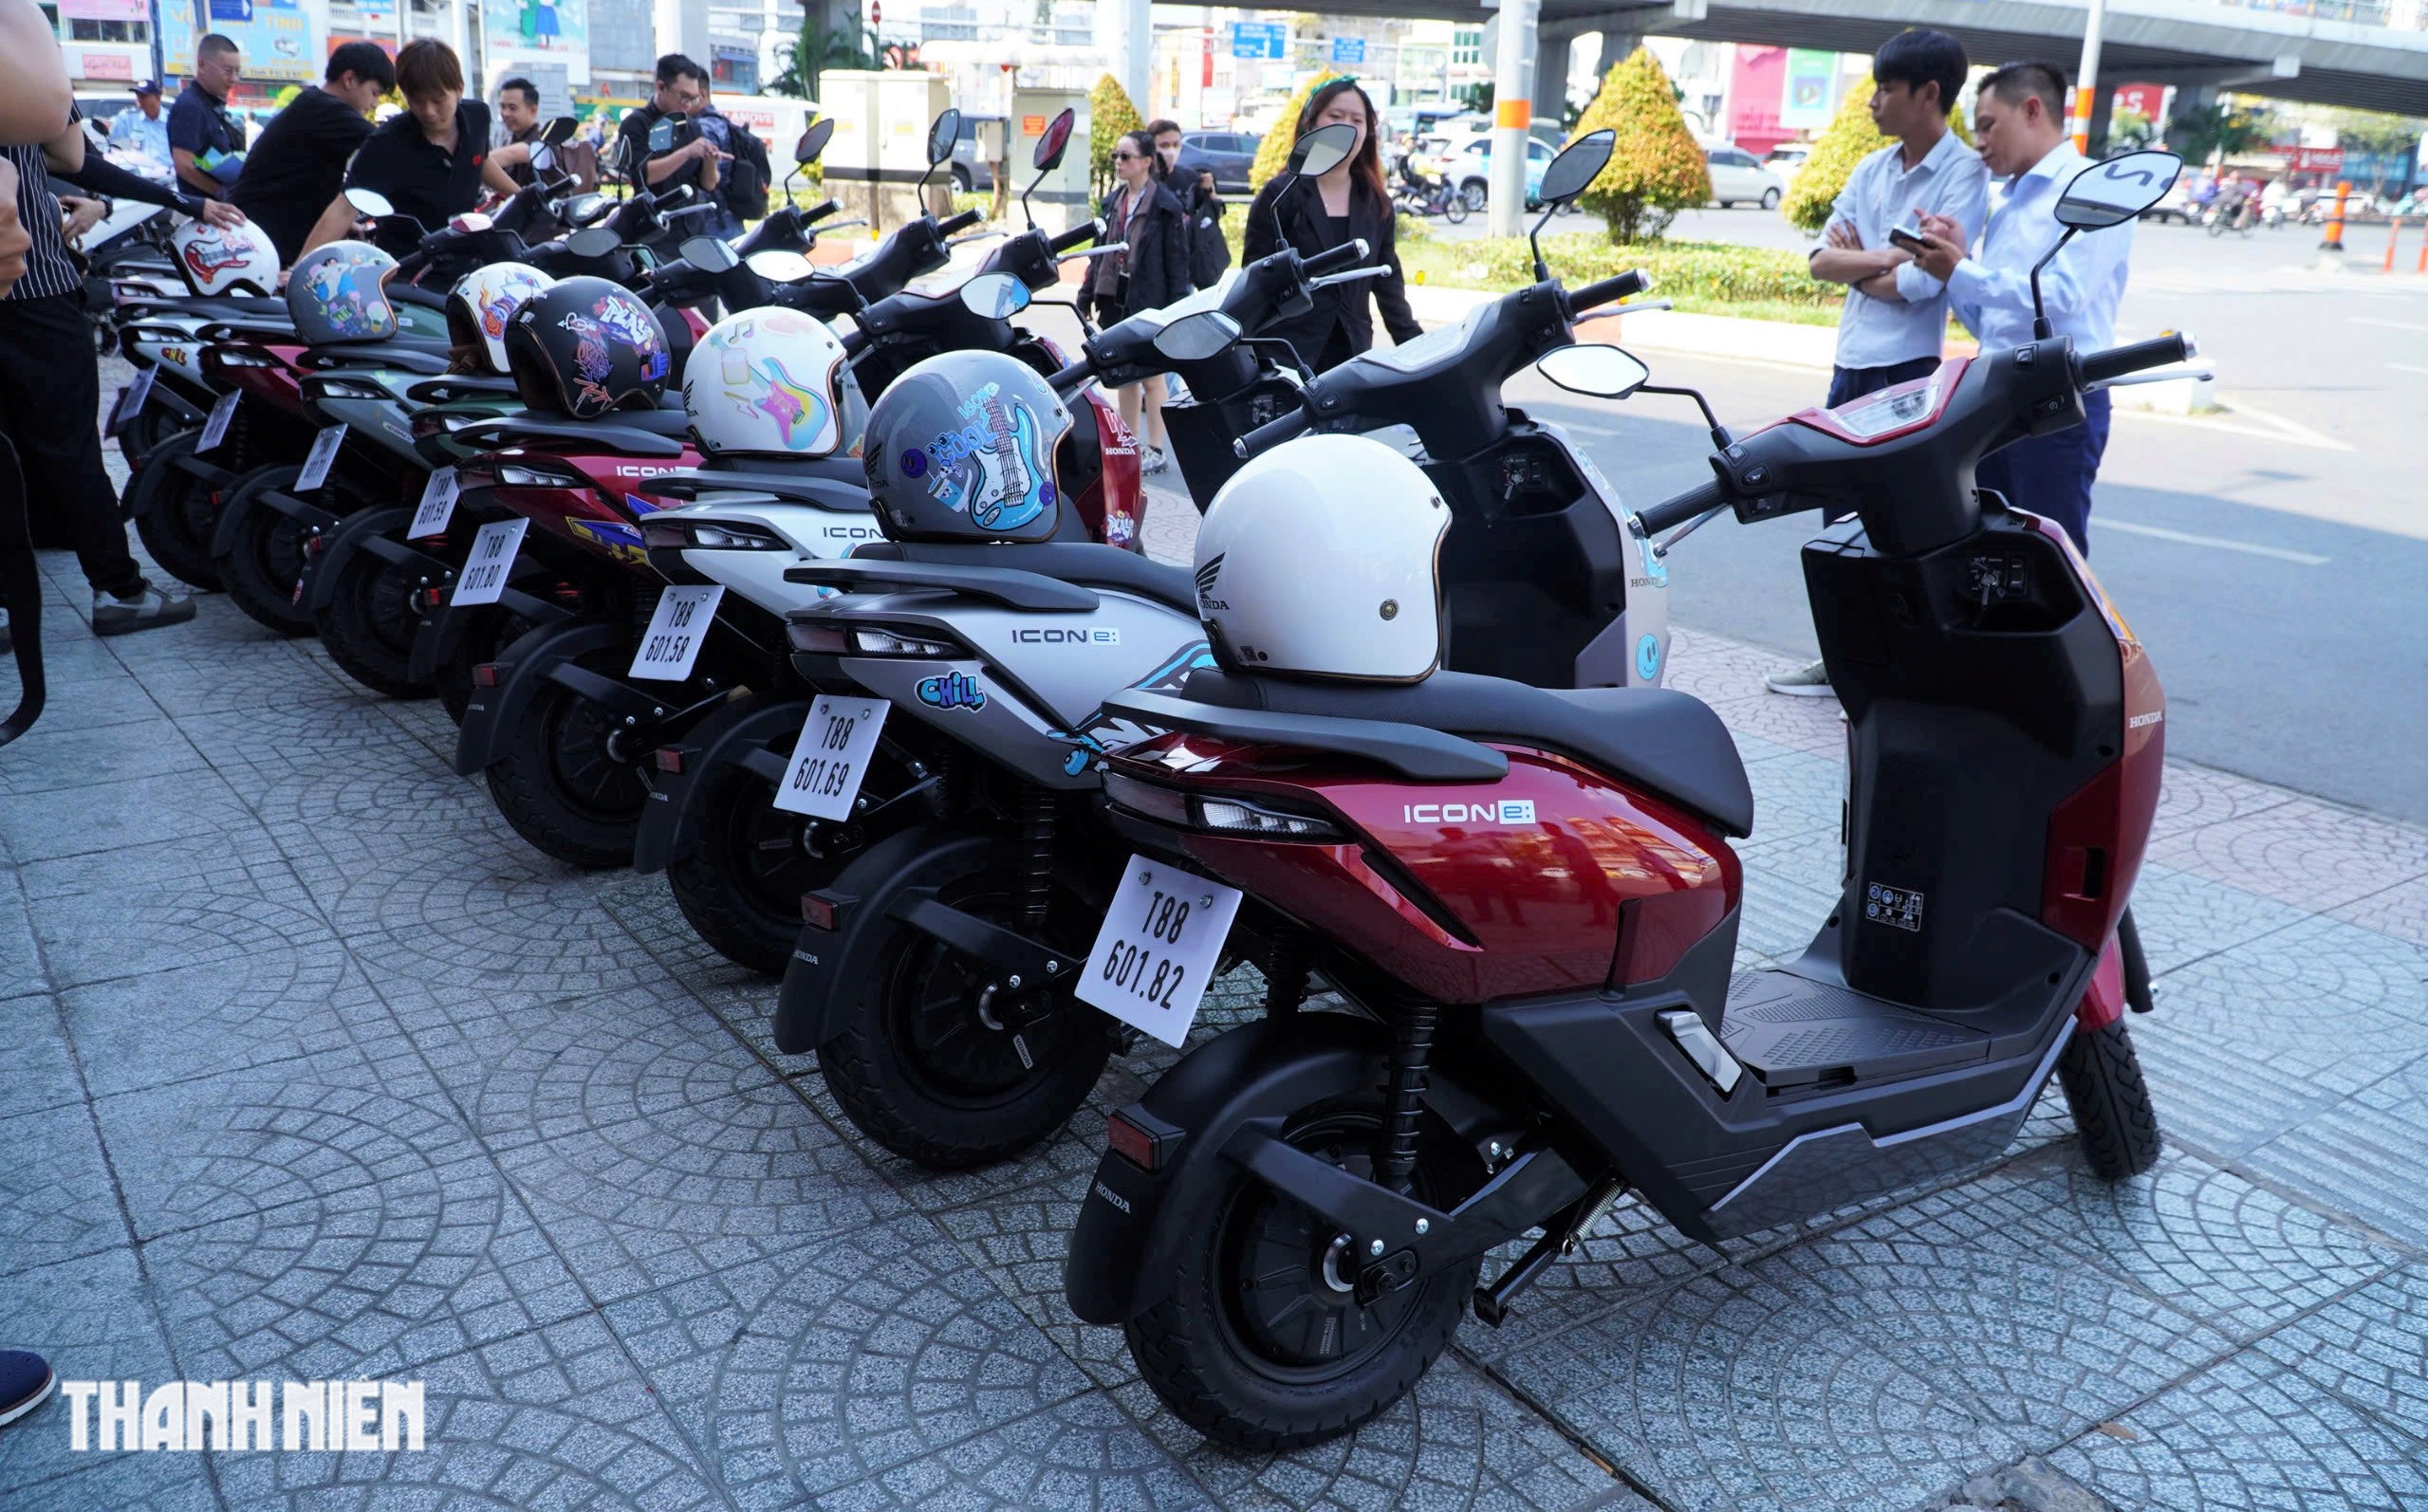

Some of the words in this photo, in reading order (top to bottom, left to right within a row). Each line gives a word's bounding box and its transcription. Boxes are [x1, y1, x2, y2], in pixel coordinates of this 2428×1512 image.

[935, 420, 998, 465] COOL
[1105, 447, 1136, 455] HONDA
[434, 476, 452, 498] T88
[484, 534, 506, 560] T88
[464, 564, 501, 591] 601.80
[668, 600, 695, 627] T88
[1200, 599, 1231, 610] ONDA
[645, 636, 690, 663] 601.58
[2129, 710, 2163, 729] HONDA
[822, 716, 855, 751] T88
[793, 757, 850, 798] 601.69
[1141, 891, 1190, 945] T88
[1103, 939, 1184, 1010] 601.82
[1095, 1181, 1131, 1214] HONDA
